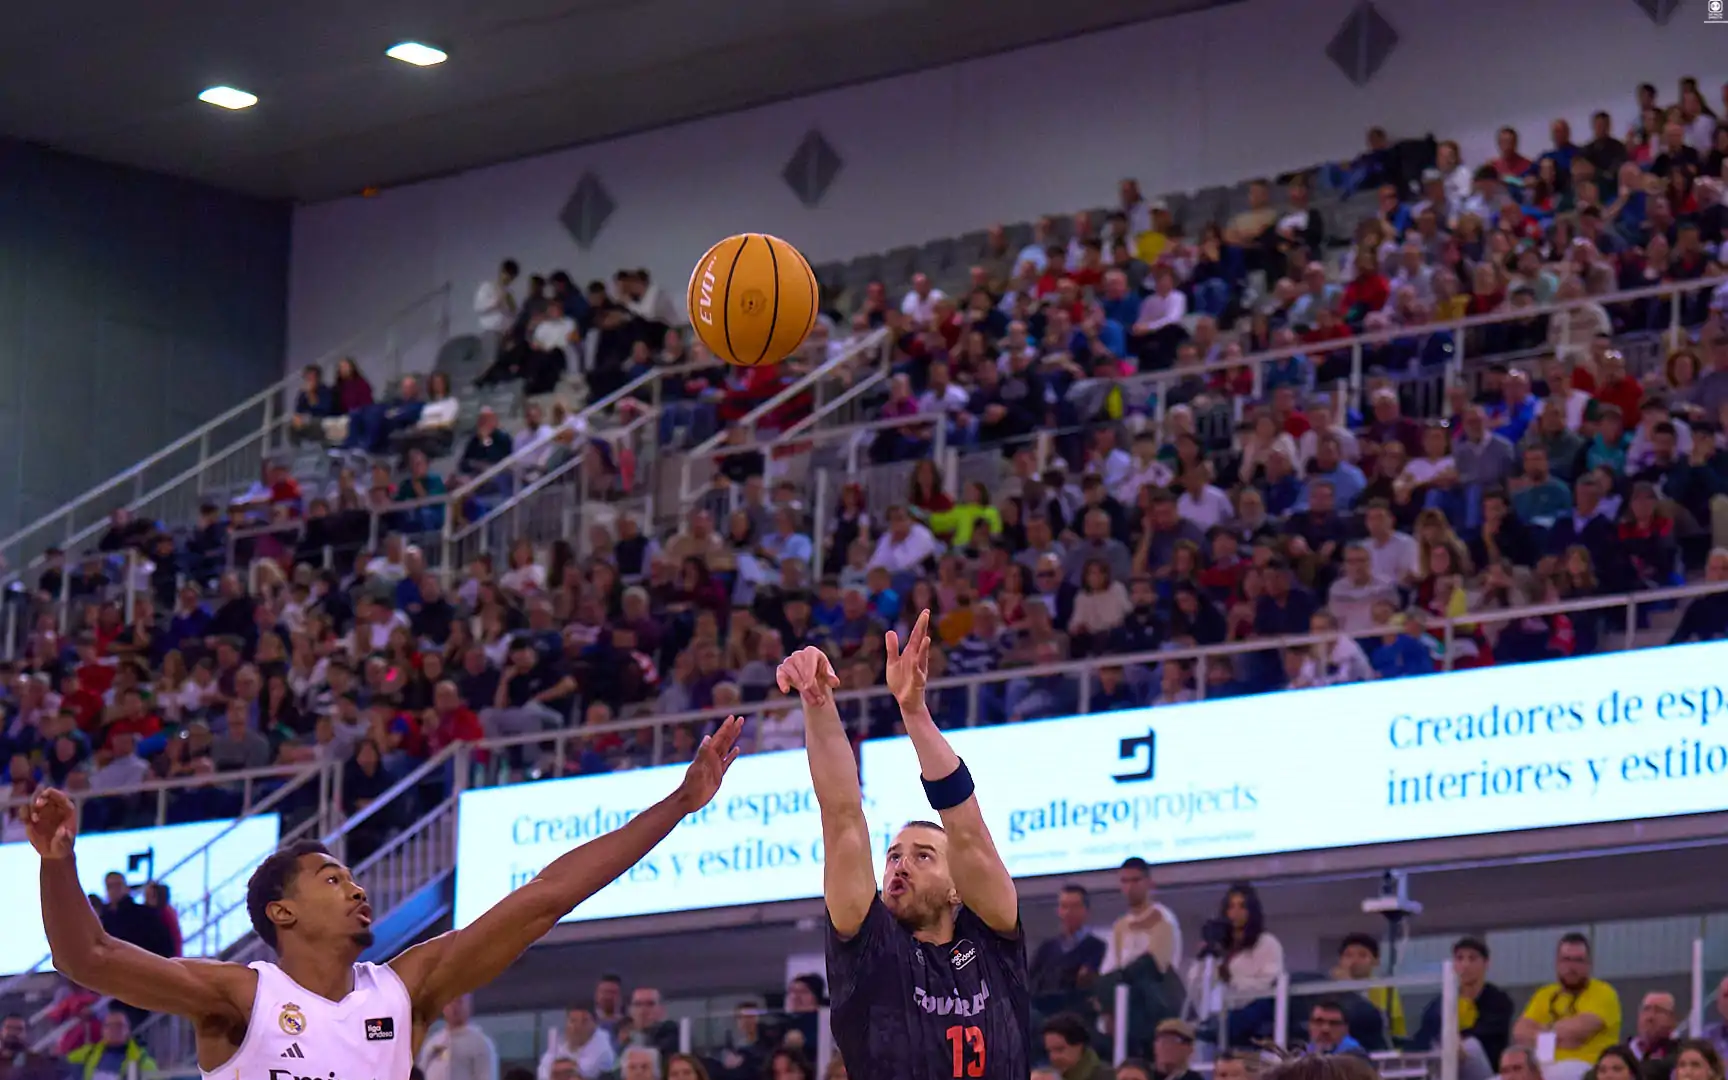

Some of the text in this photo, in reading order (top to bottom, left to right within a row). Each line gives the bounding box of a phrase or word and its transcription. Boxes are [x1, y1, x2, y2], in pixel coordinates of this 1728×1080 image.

[1388, 703, 1584, 750] Creadores
[1596, 690, 1643, 727] de
[1386, 758, 1573, 806] interiores
[1586, 755, 1607, 797] y
[1008, 782, 1259, 843] gallegoprojects
[697, 837, 801, 877] estilos
[946, 1025, 987, 1078] 13
